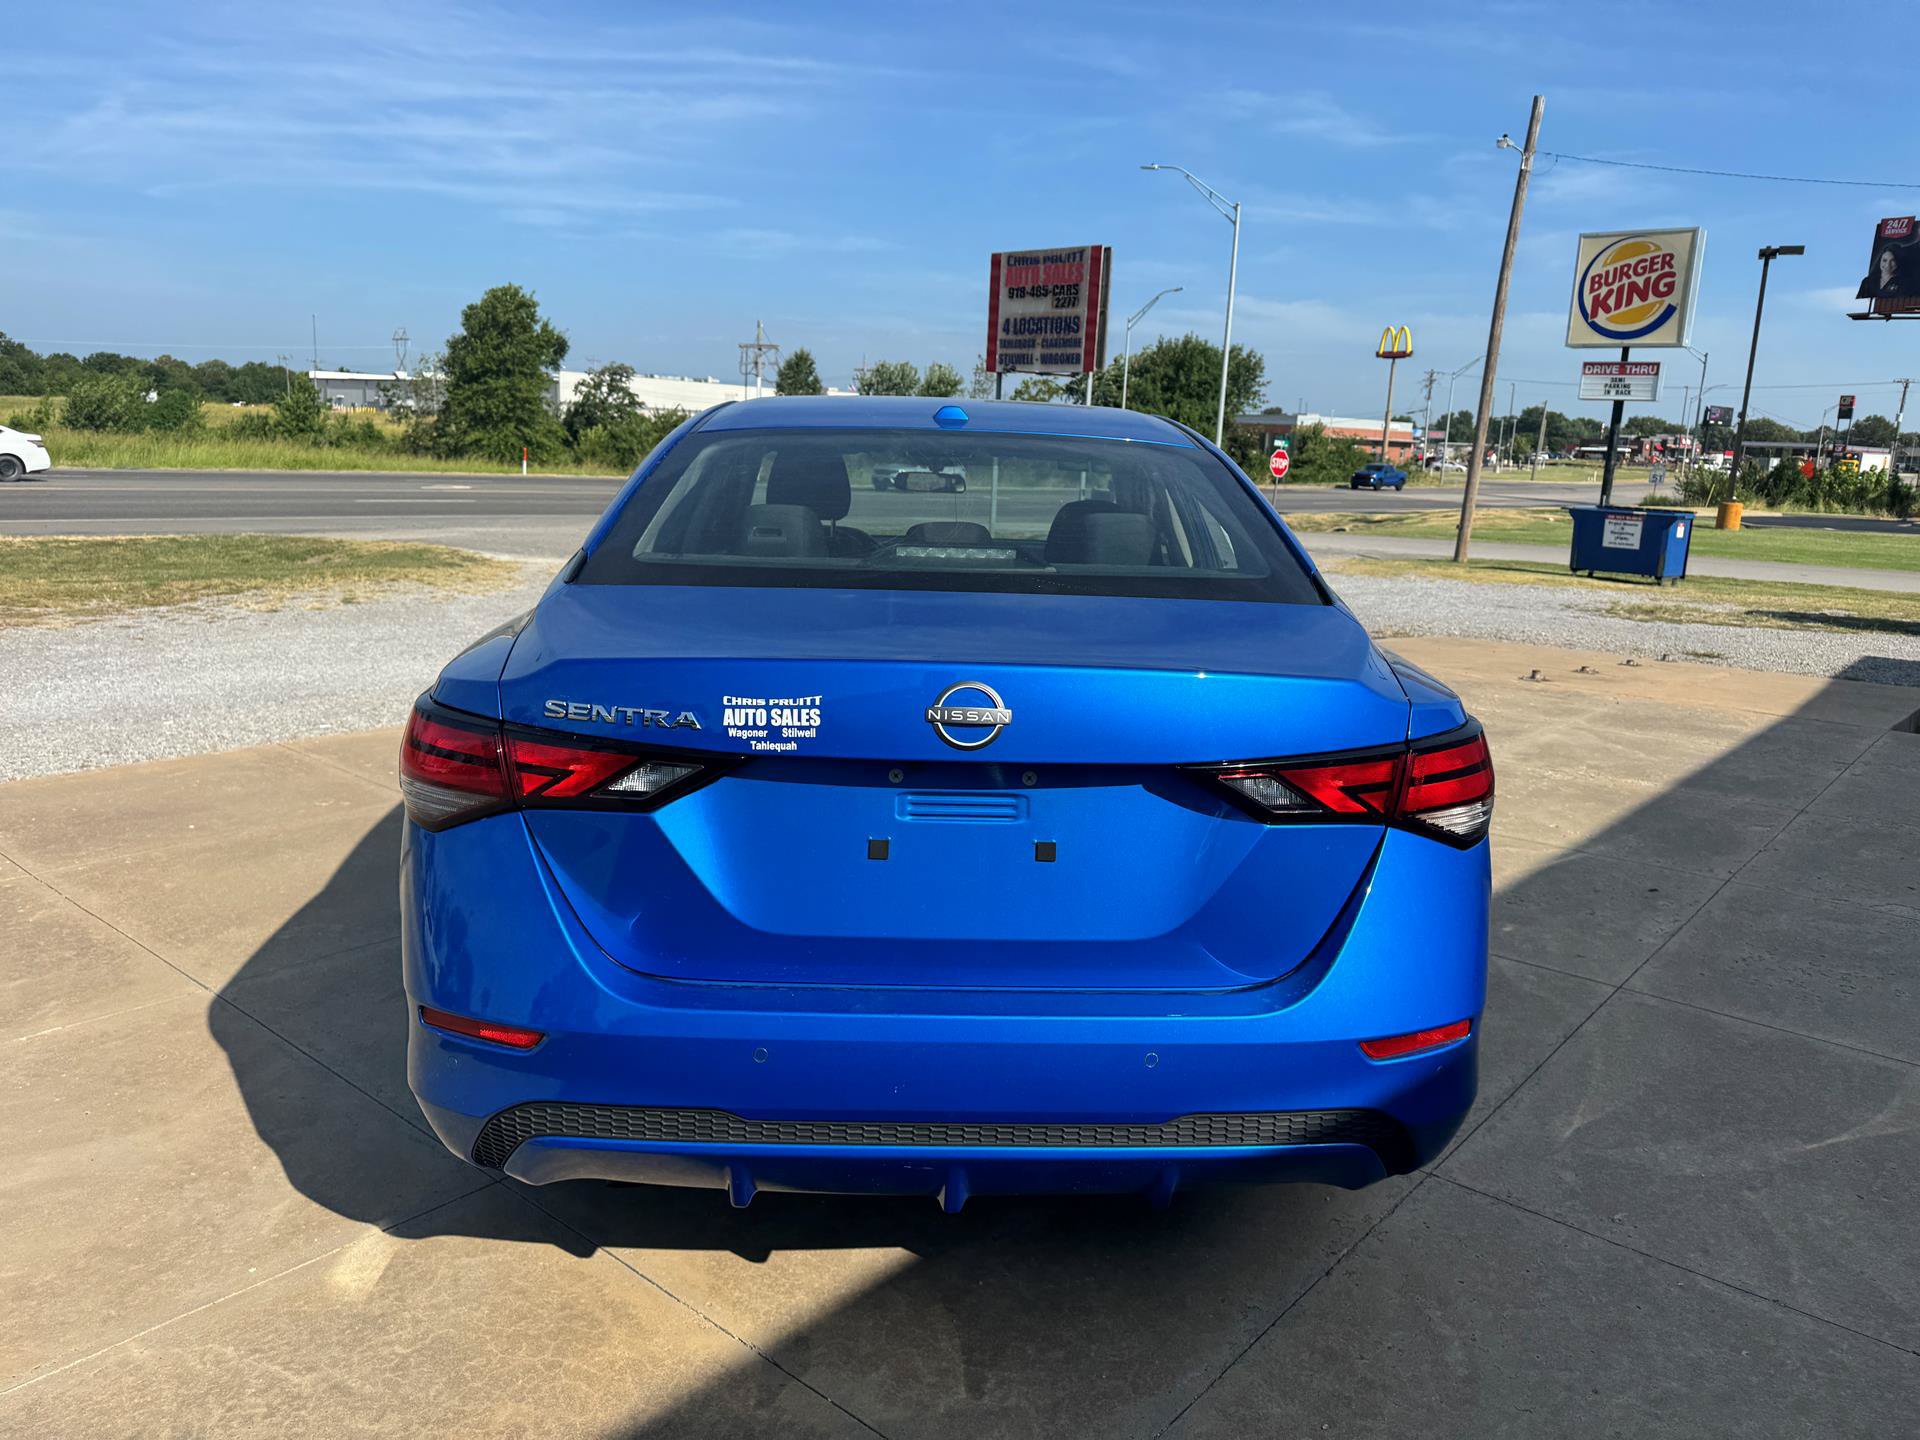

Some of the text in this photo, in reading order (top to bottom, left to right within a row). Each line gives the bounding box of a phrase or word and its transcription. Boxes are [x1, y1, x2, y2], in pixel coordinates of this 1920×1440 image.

[1887, 219, 1909, 229] 24/7
[1589, 252, 1676, 294] BURGER
[1590, 271, 1677, 320] KING
[1003, 315, 1081, 335] 4 LOCATIONS
[1585, 364, 1658, 375] DRIVE THRU
[1271, 457, 1289, 469] STOP
[723, 695, 823, 705] CHRIS PRUITT
[544, 699, 702, 730] SENTRA
[723, 708, 821, 726] AUTO SALES
[928, 709, 1009, 723] NISSAN
[728, 727, 816, 739] Wagoner Stilwell
[750, 741, 797, 752] Tahlequah
